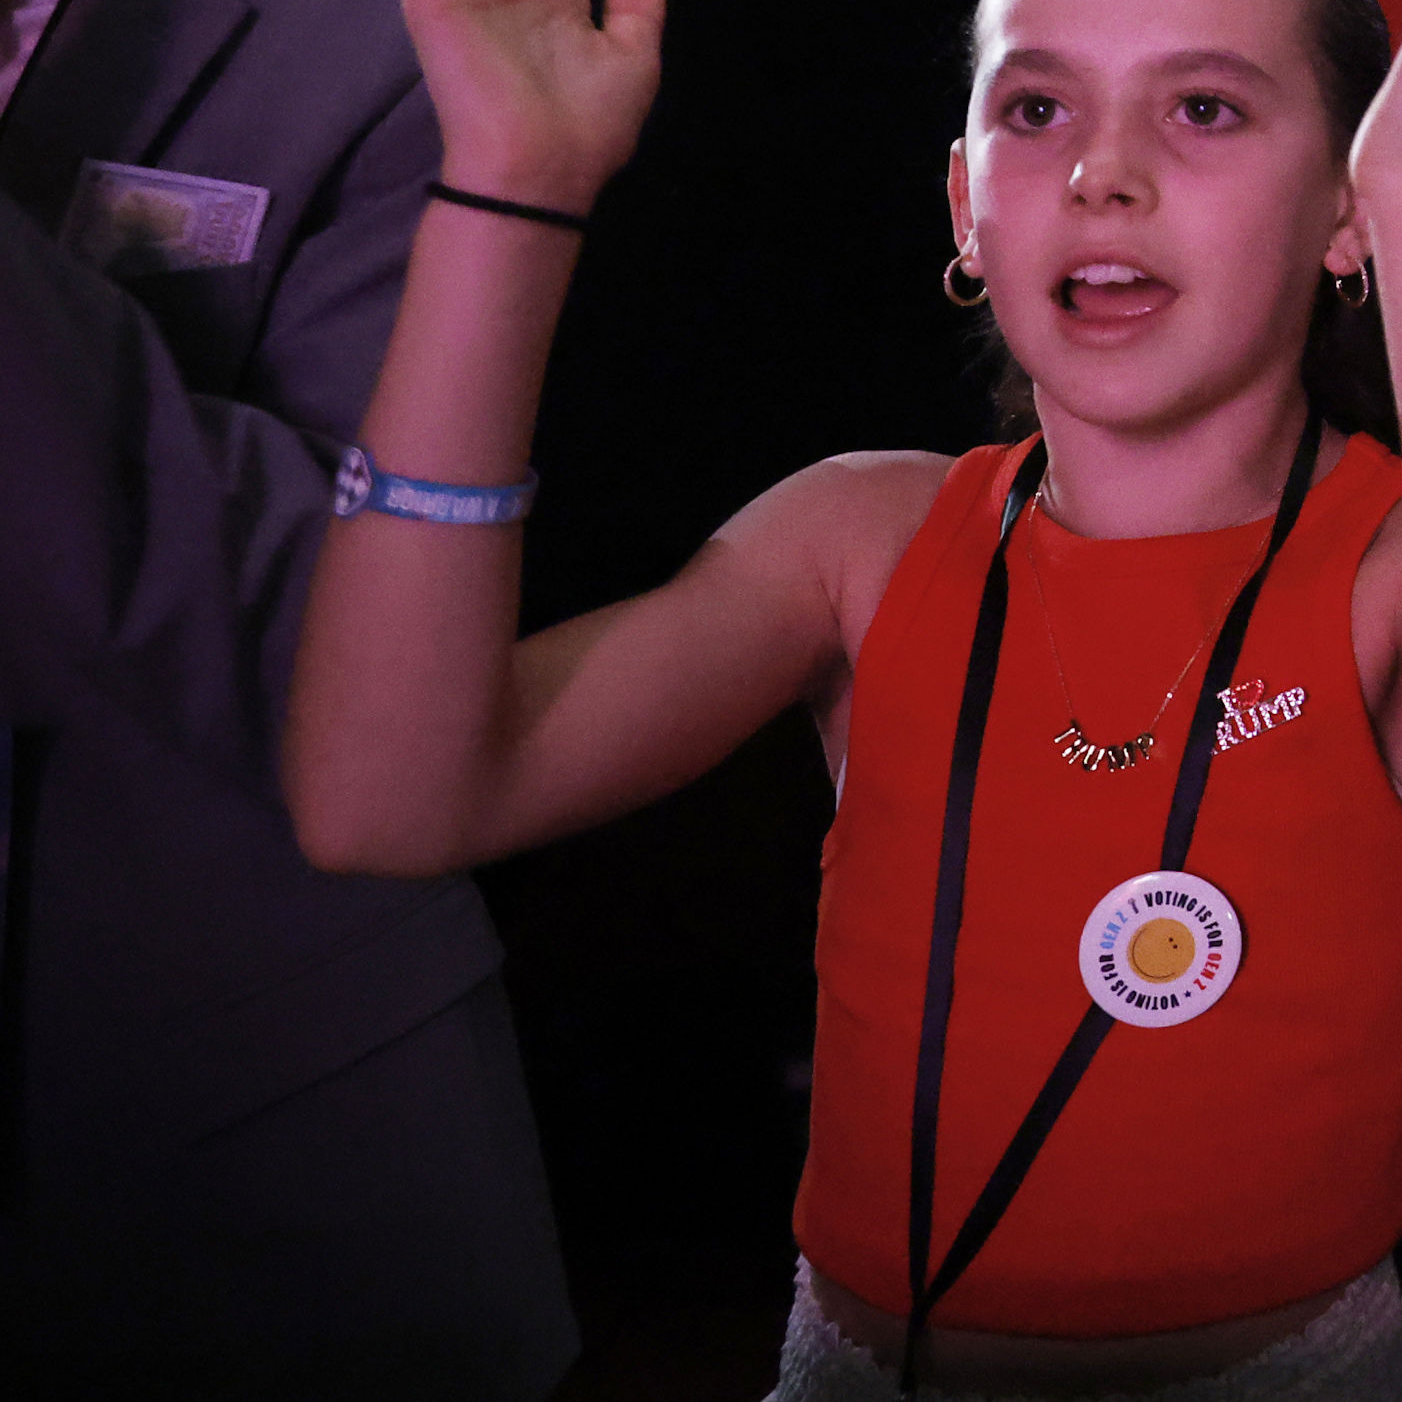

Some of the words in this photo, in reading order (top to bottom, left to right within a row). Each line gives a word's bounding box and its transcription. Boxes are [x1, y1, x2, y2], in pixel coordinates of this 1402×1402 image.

[1213, 687, 1305, 755] RUMP
[1144, 891, 1197, 912] VOTING
[1195, 905, 1212, 923] IS
[1203, 921, 1223, 948] FOR
[1098, 953, 1118, 981] FOR
[1110, 980, 1128, 997] IS
[1125, 990, 1180, 1010] VOTING
